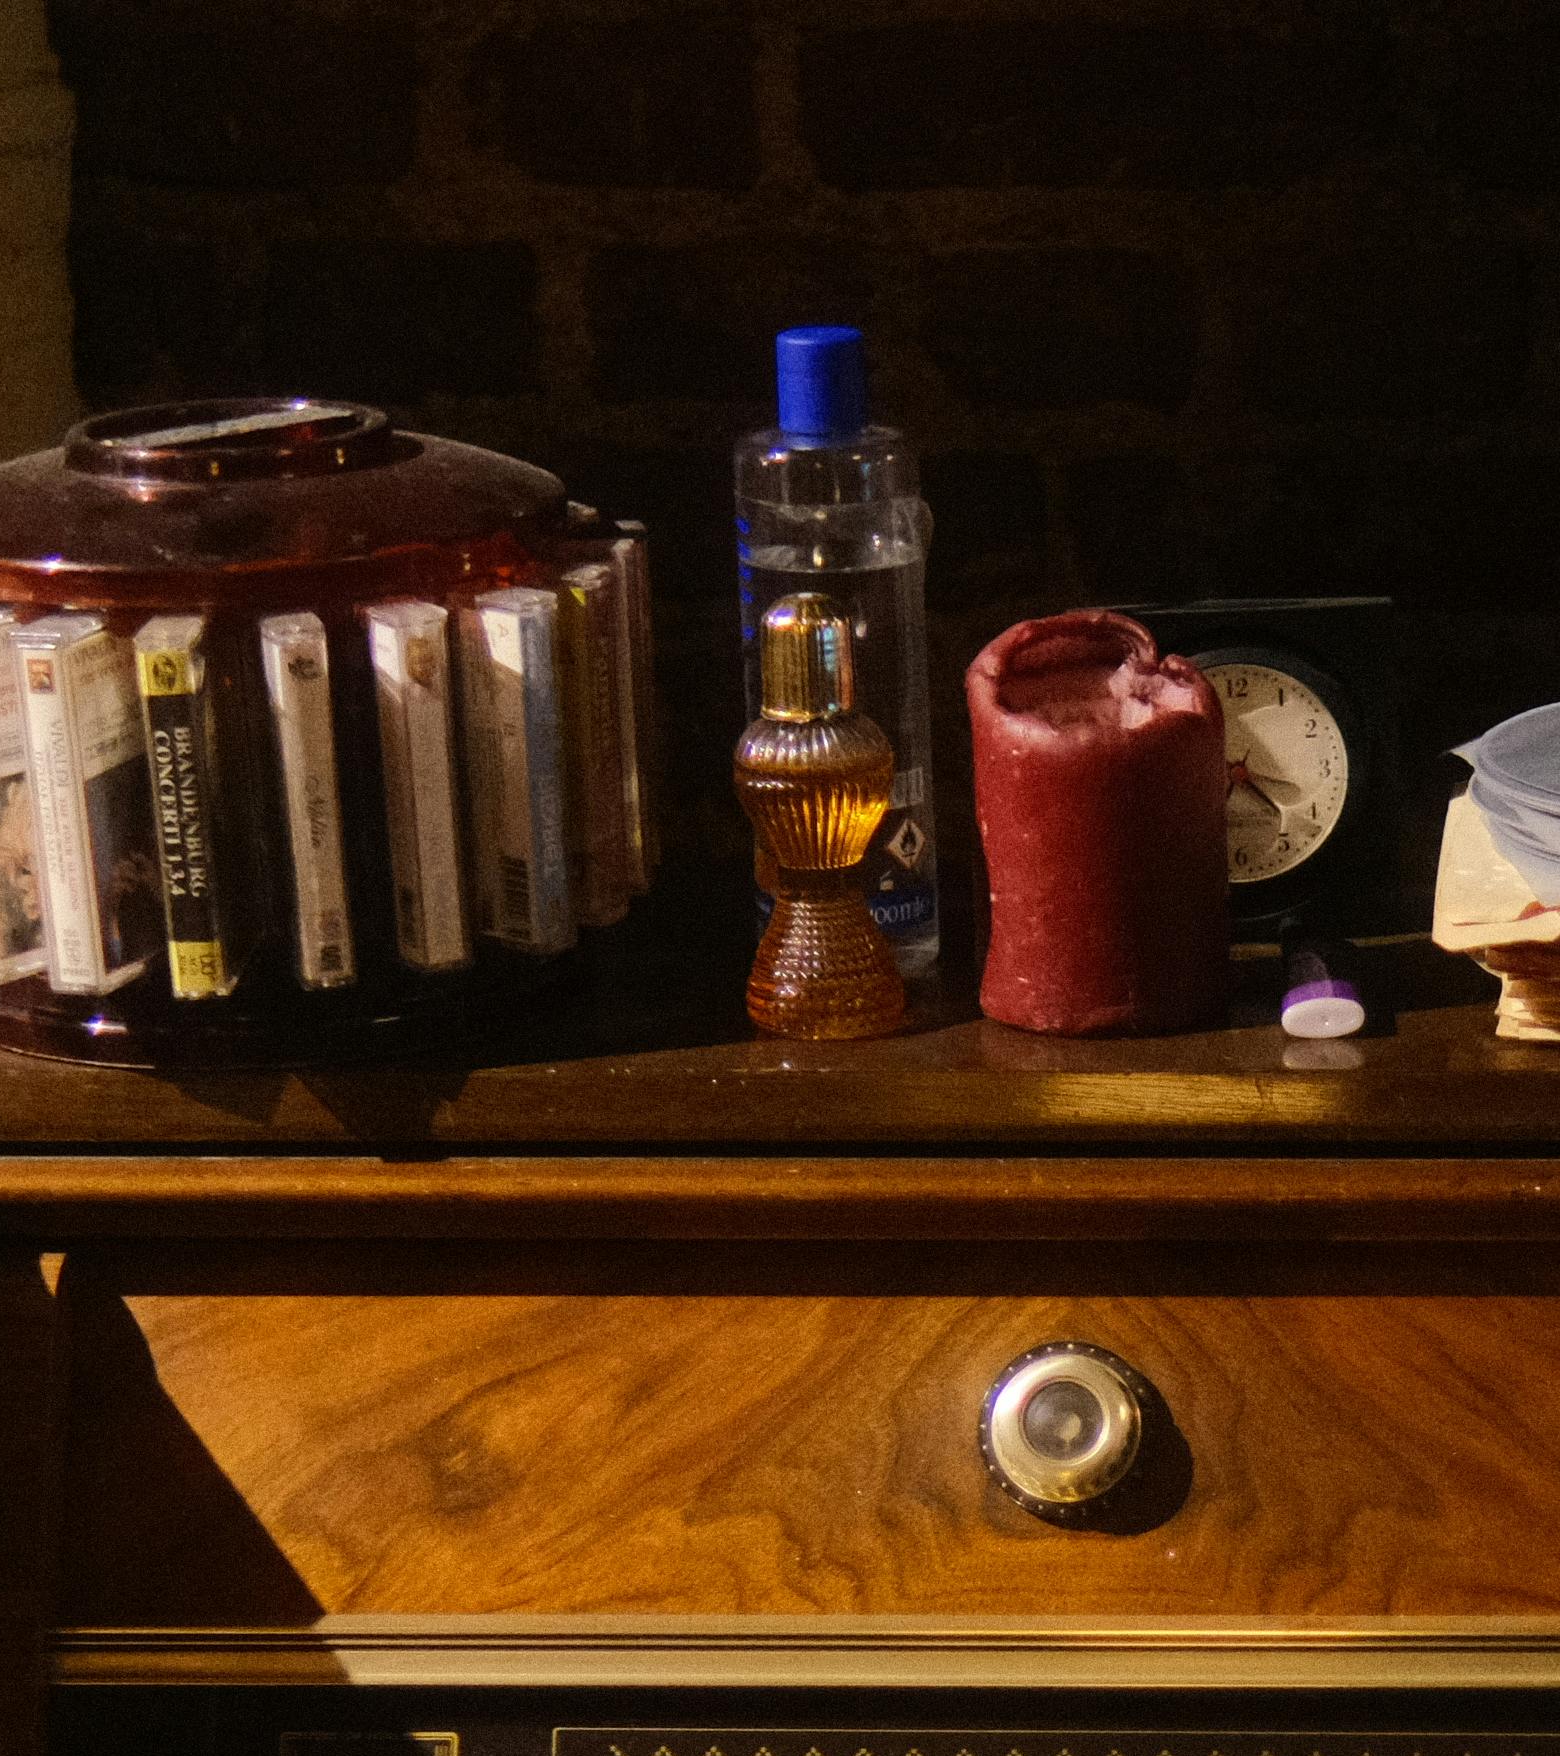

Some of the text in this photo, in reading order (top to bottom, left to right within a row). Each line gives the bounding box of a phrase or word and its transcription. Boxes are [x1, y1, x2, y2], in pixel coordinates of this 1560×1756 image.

[1226, 679, 1248, 698] 12
[1278, 687, 1284, 707] 1
[1304, 718, 1318, 739] 2
[50, 718, 71, 787] VIVALDI
[1319, 759, 1332, 779] 3
[152, 730, 188, 897] CONCERTI 1,3,4
[173, 725, 208, 898] BRANDENBURG
[1303, 802, 1317, 820] 4
[1278, 831, 1291, 853] 5
[1235, 847, 1248, 866] 6
